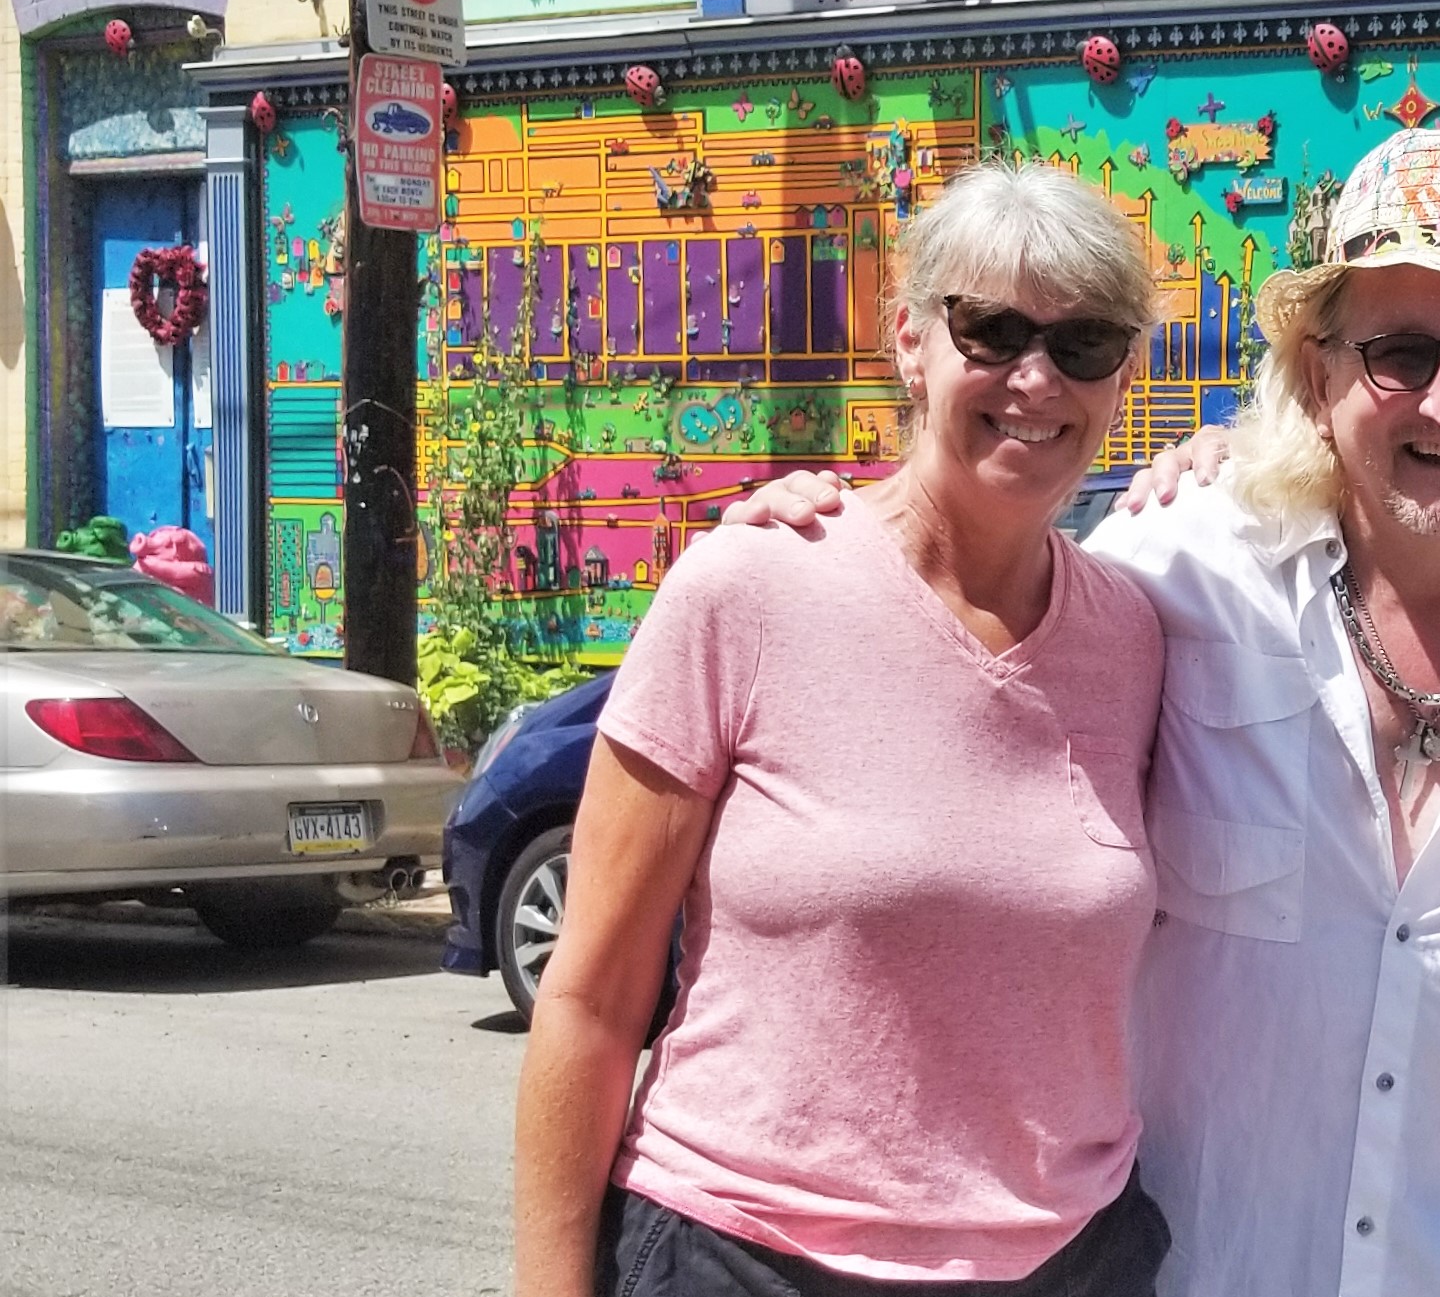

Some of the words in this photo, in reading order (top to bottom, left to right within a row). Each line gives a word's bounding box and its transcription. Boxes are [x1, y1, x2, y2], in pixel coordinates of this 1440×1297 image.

[378, 4, 398, 16] THIS
[401, 8, 426, 21] STREET
[428, 12, 436, 23] IS
[388, 21, 428, 38] CONTINUAL
[431, 29, 453, 42] WATCH
[390, 38, 401, 49] BY
[374, 61, 425, 82] STREET
[366, 77, 435, 99] CLEANING
[1363, 102, 1383, 121] W
[362, 143, 379, 157] NO
[384, 144, 436, 163] PARKING
[1233, 179, 1282, 201] WELCOME
